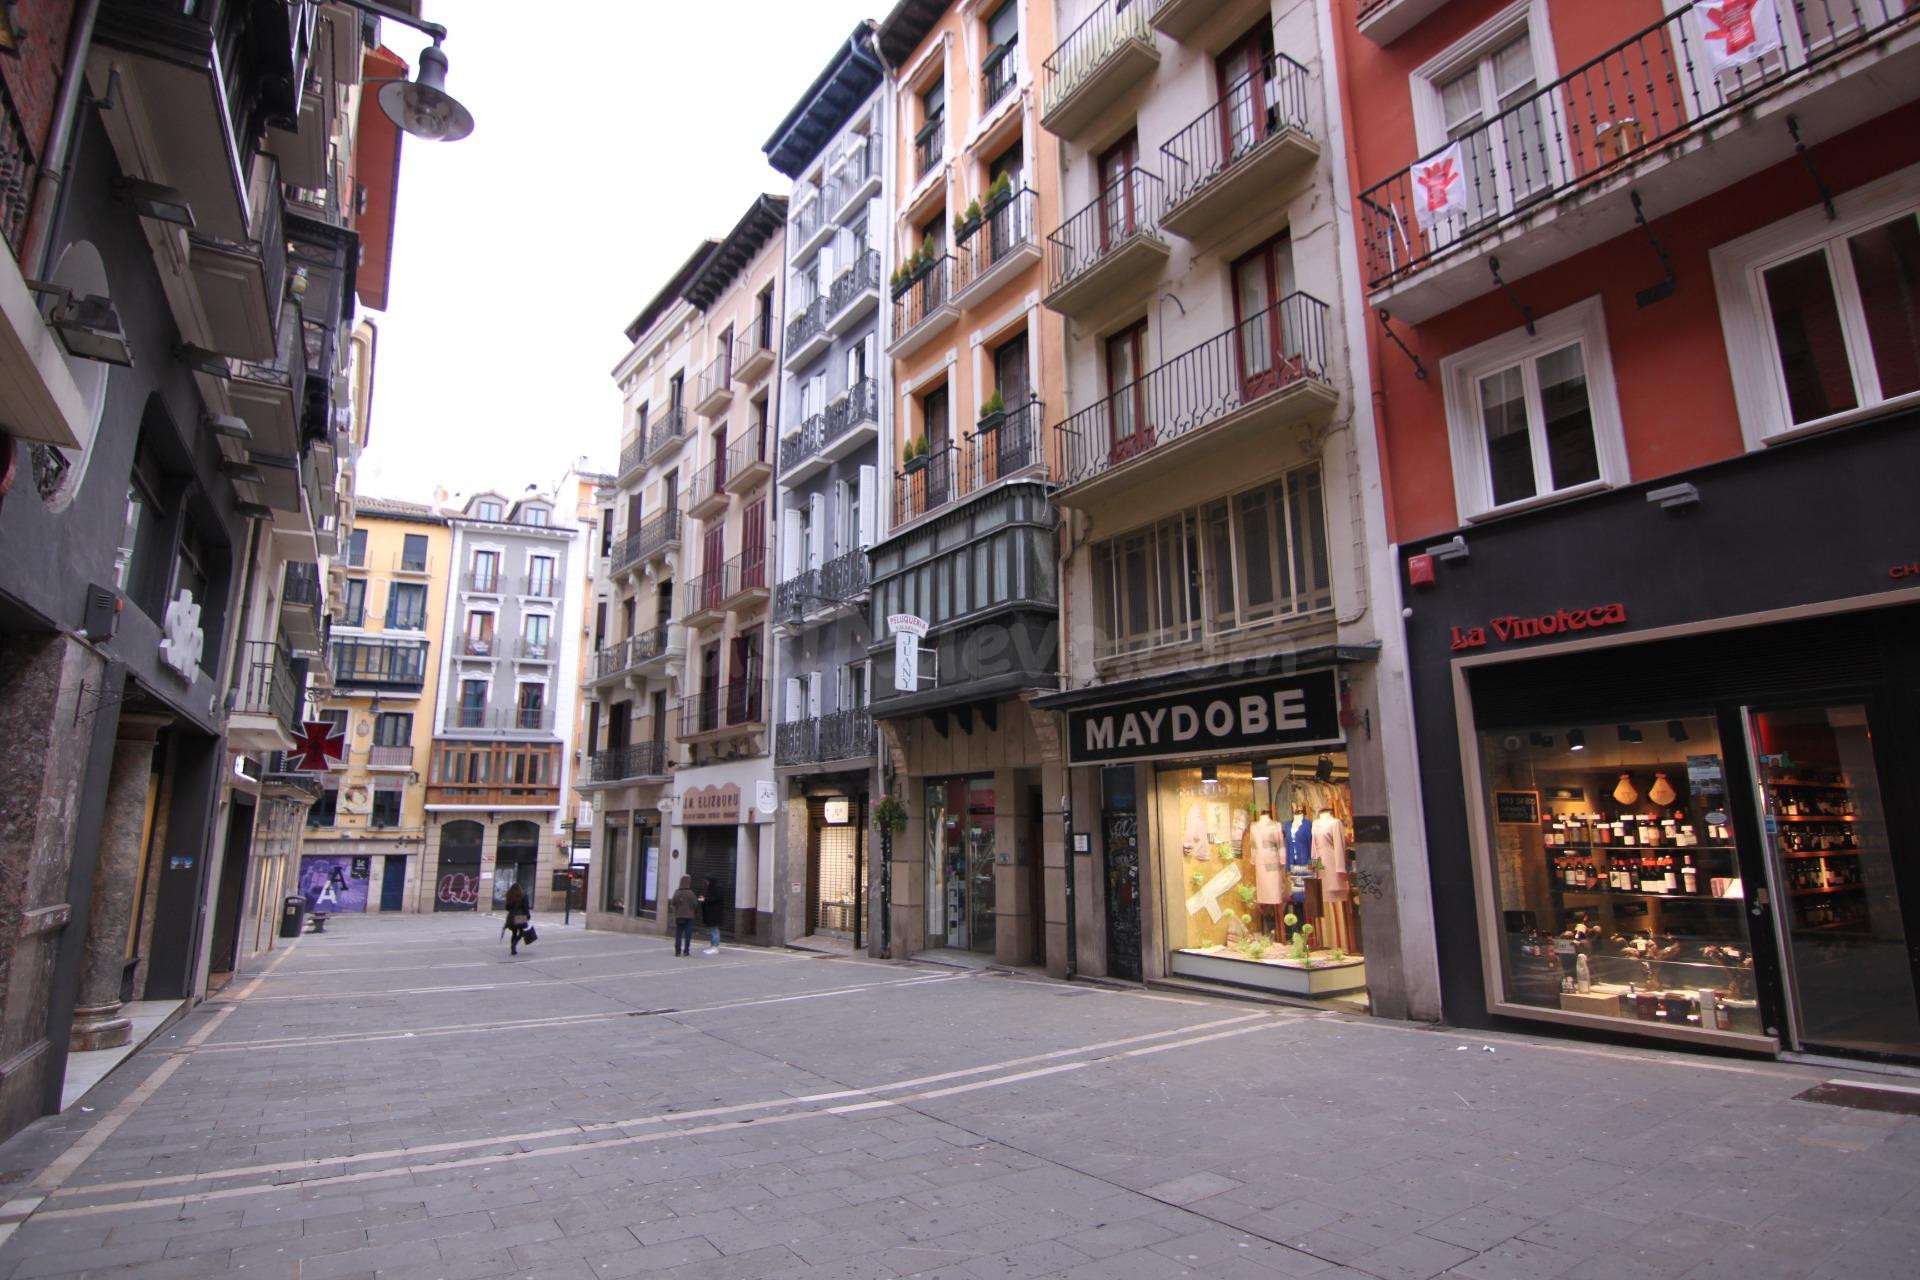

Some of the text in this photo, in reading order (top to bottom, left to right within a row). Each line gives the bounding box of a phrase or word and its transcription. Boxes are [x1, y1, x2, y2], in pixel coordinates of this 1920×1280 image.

[1450, 602, 1627, 650] La Vinoteca
[902, 635, 912, 689] JUANY
[1086, 688, 1307, 751] MAYDOBE
